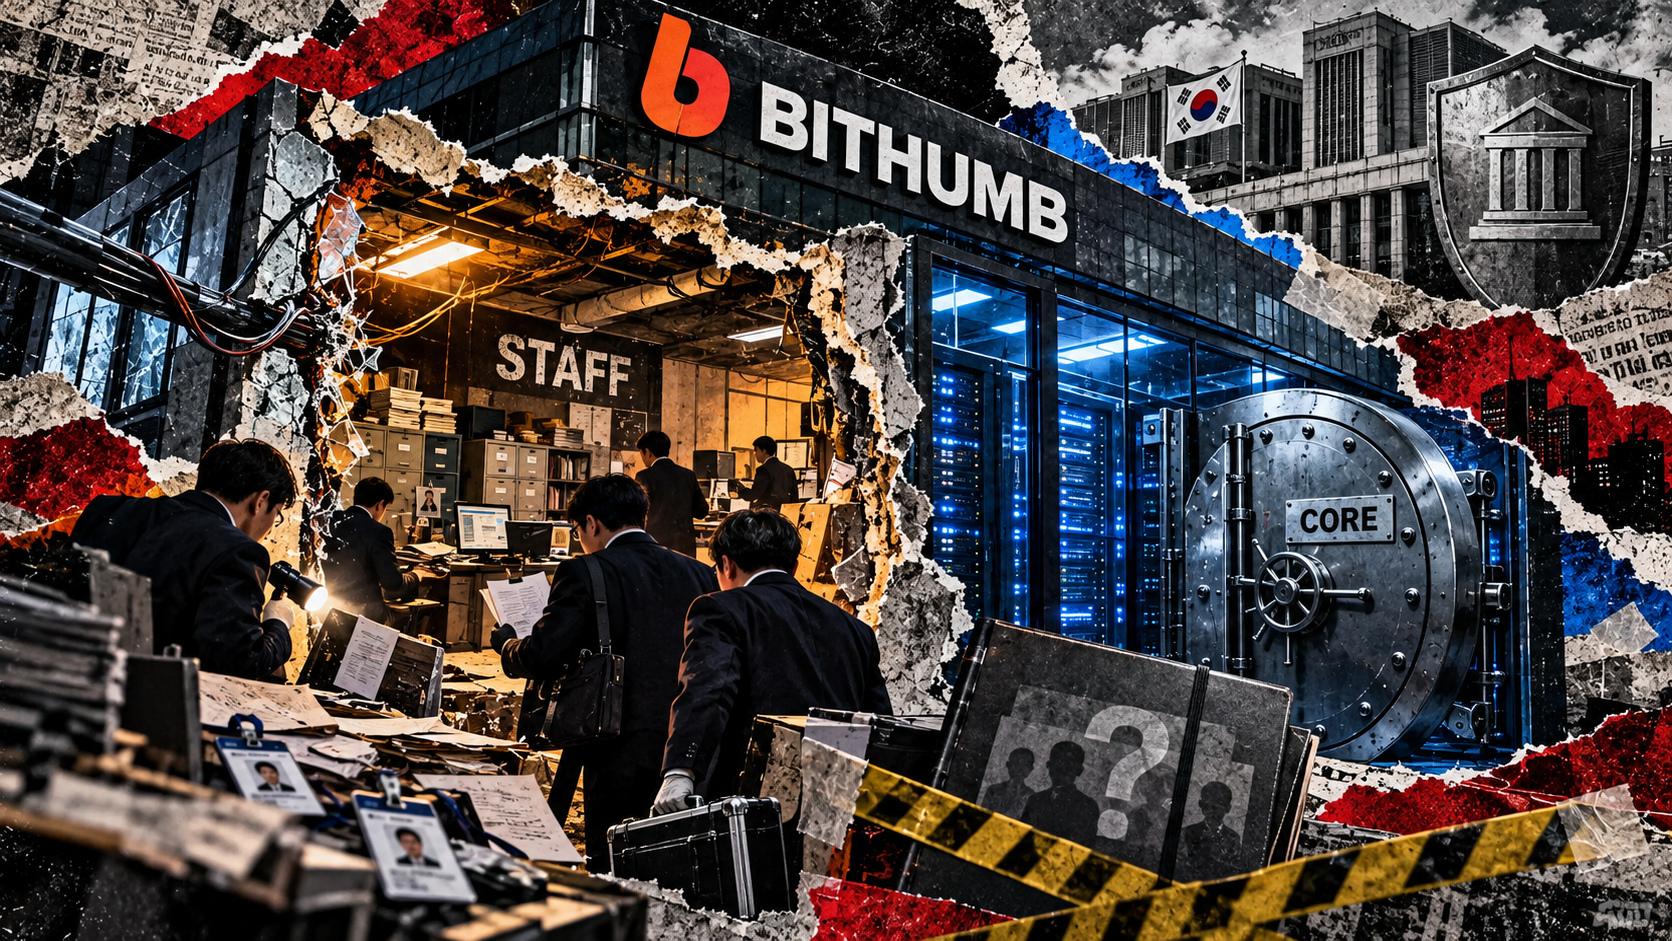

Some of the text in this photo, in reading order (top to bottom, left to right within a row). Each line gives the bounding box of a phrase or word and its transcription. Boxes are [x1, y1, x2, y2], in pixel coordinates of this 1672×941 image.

[760, 80, 1068, 244] BITHUMB
[496, 333, 632, 397] STAFF
[1300, 506, 1378, 534] CORE
